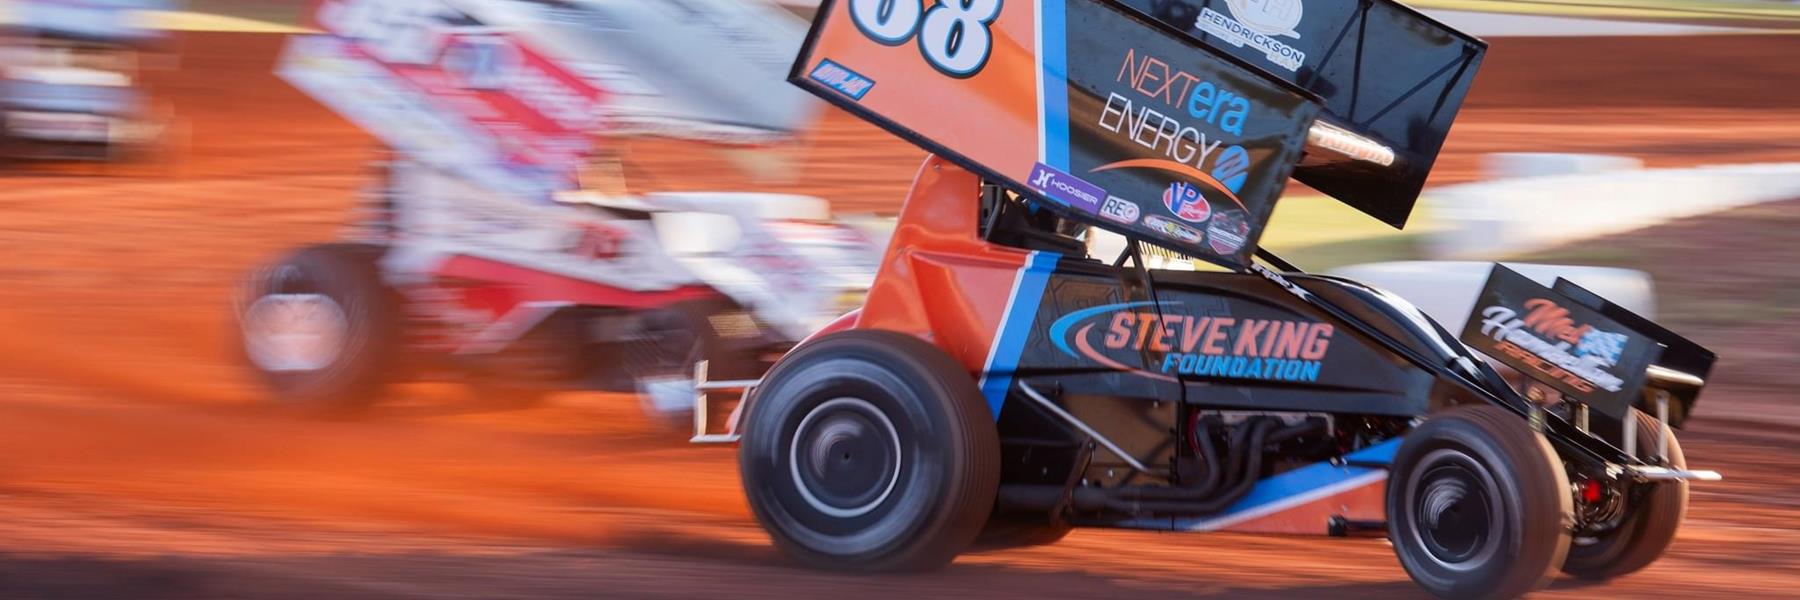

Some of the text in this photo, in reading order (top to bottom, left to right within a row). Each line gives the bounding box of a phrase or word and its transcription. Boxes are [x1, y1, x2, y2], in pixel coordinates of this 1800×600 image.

[1202, 10, 1303, 63] HENDRICKSON
[1098, 91, 1222, 169] ENERGY
[1051, 178, 1098, 206] HOOSIER
[1170, 181, 1201, 214] VP
[1104, 311, 1334, 361] STEVE KING
[1161, 353, 1321, 382] FOUNDATION
